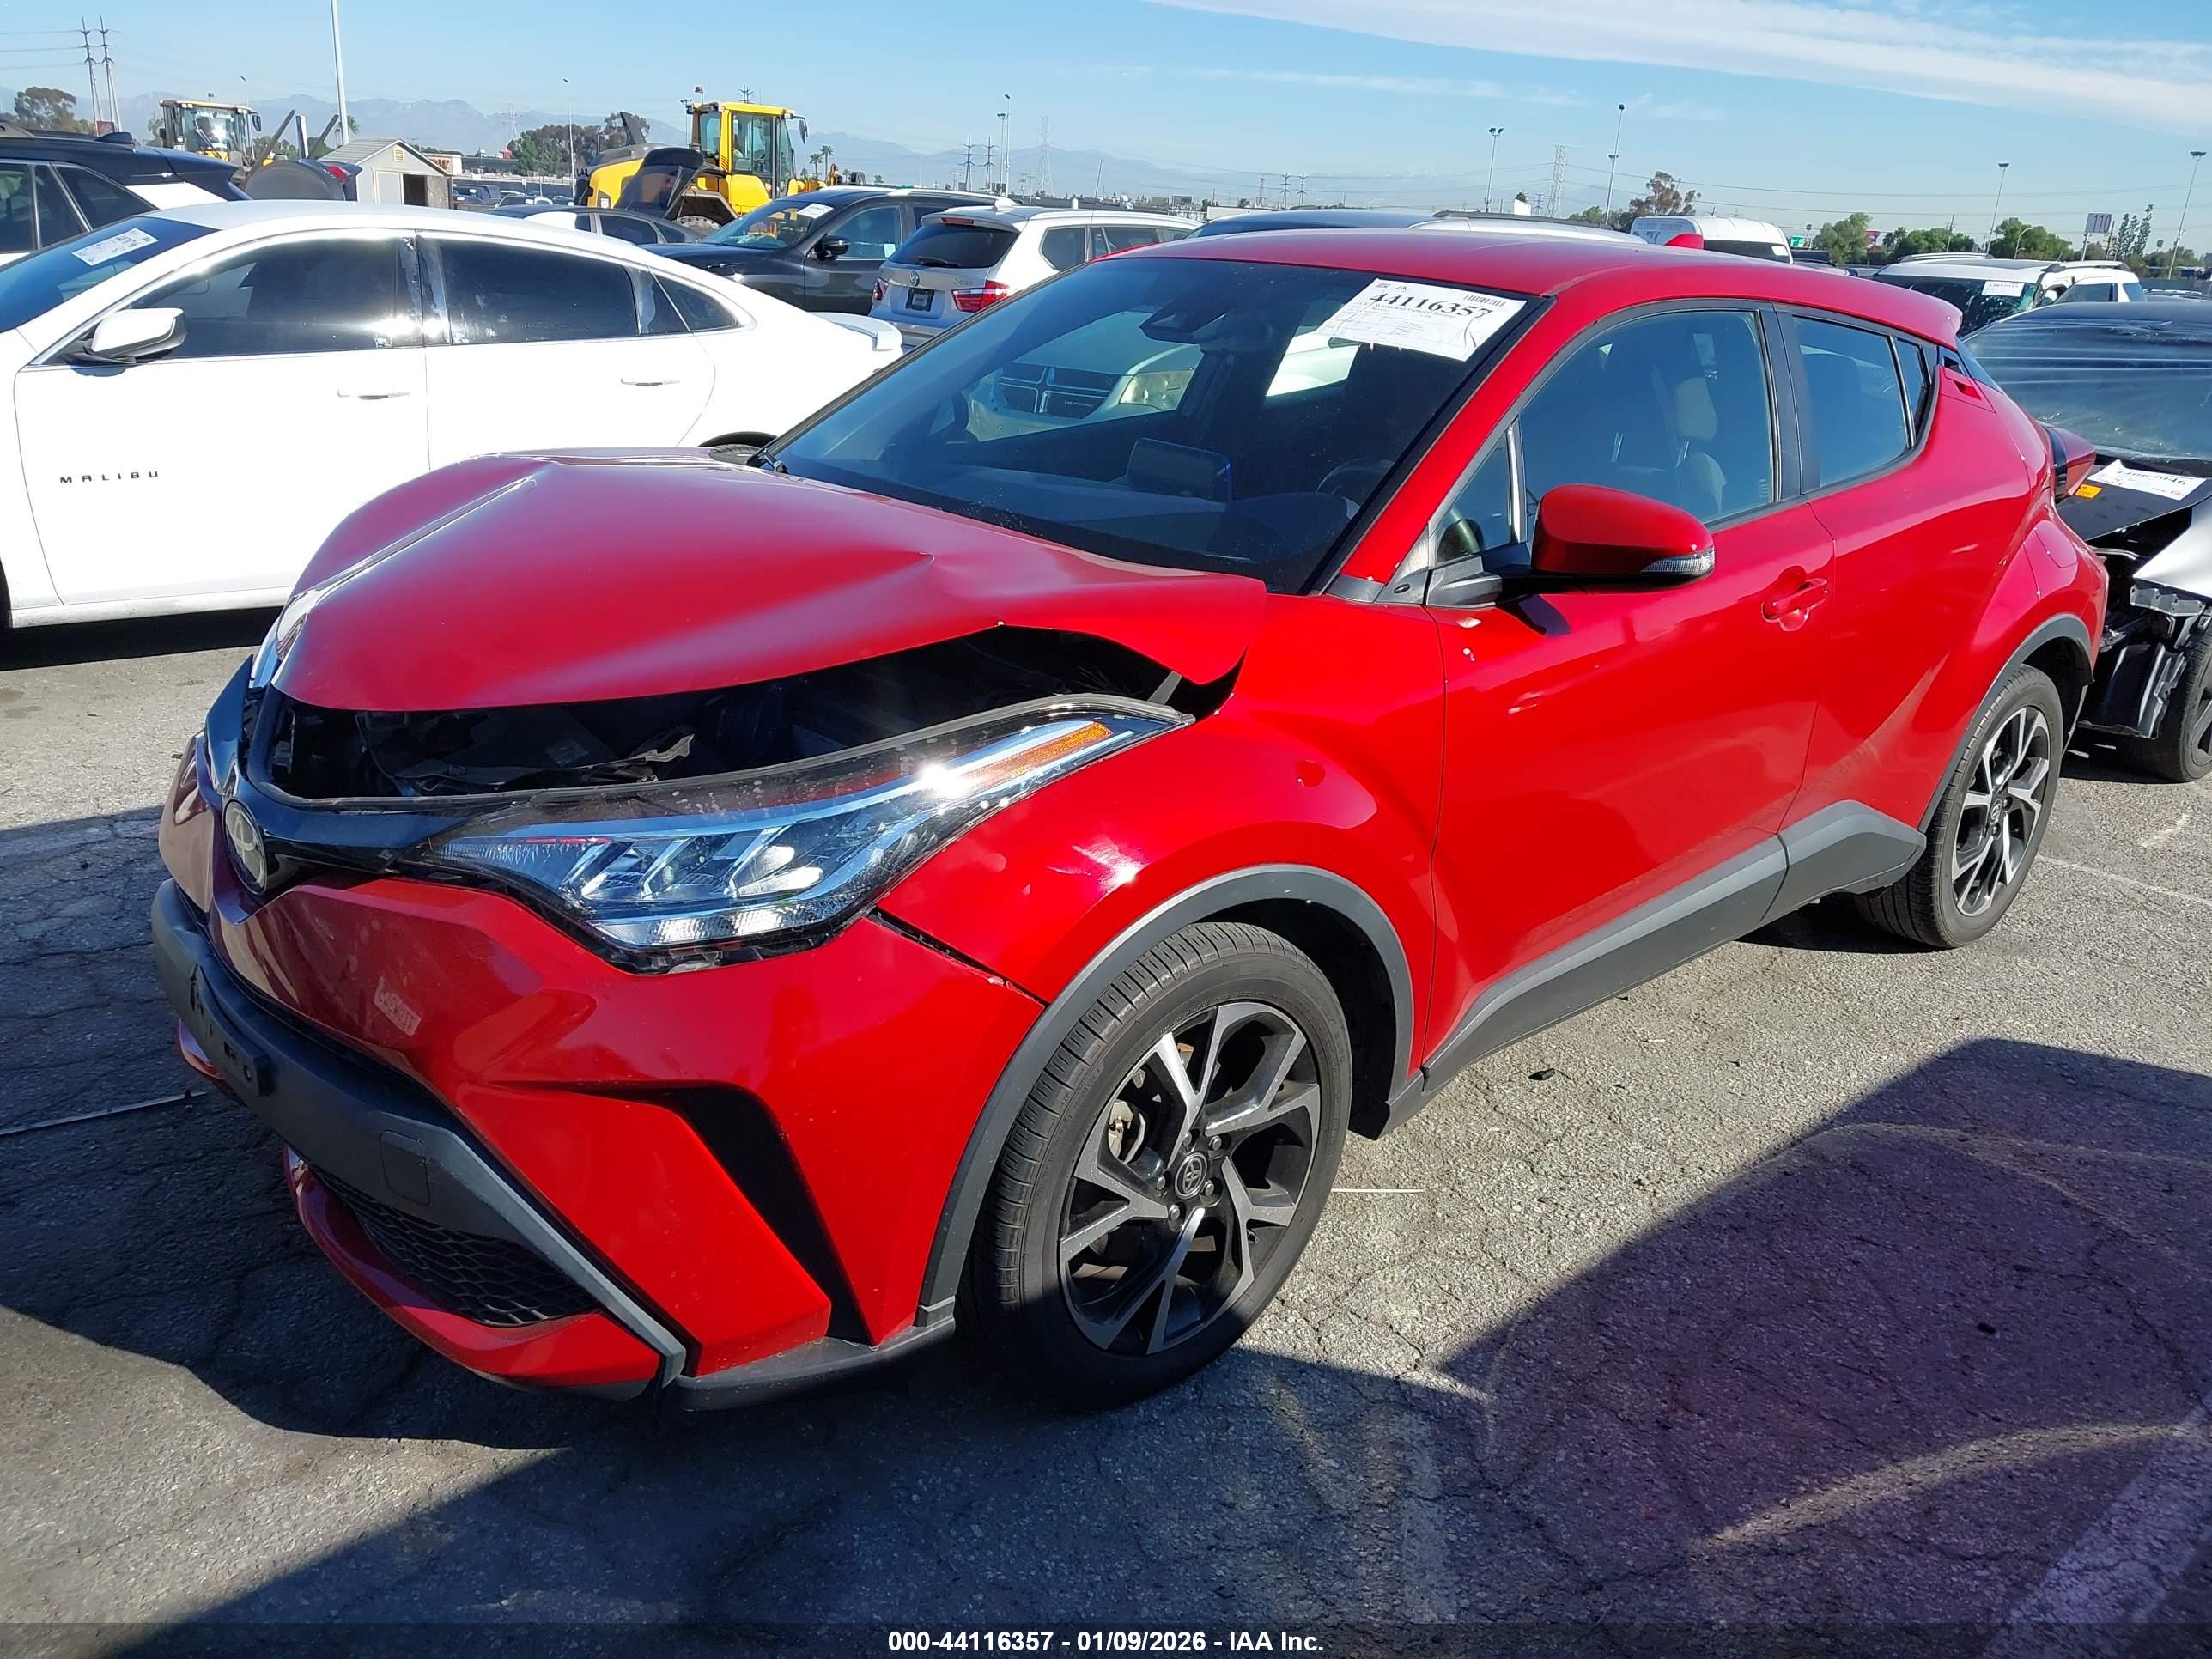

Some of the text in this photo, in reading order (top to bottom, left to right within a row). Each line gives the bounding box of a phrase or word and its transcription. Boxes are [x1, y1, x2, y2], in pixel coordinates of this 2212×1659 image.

[2093, 214, 2111, 233] 110
[1370, 293, 1494, 319] 44116357
[59, 471, 159, 483] MALIBU
